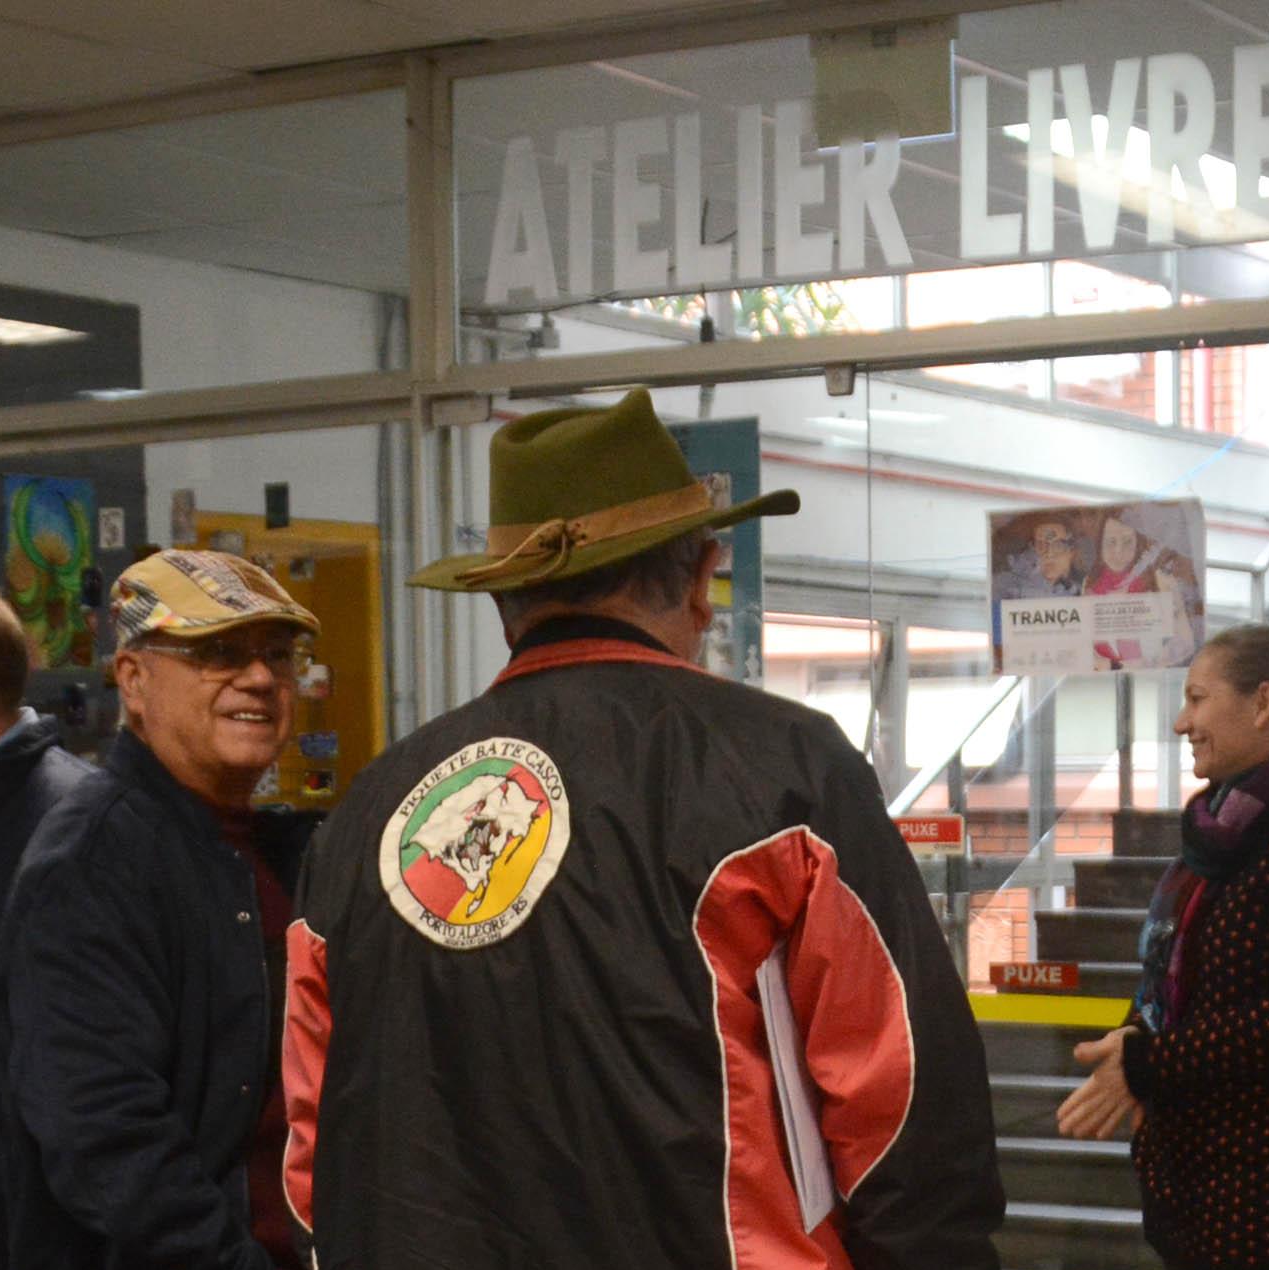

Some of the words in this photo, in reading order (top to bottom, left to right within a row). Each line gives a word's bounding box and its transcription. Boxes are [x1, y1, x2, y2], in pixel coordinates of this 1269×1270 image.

[485, 92, 913, 304] ATELIER
[1010, 609, 1081, 628] TRANÇA
[400, 751, 470, 818] PIQUETE
[475, 740, 526, 761] BATE
[525, 750, 563, 802] CASCO
[898, 822, 939, 839] PUXE
[419, 910, 457, 939] PORTO
[458, 916, 509, 939] ALEGRE
[512, 896, 528, 915] RS
[1003, 965, 1062, 984] PUXE
